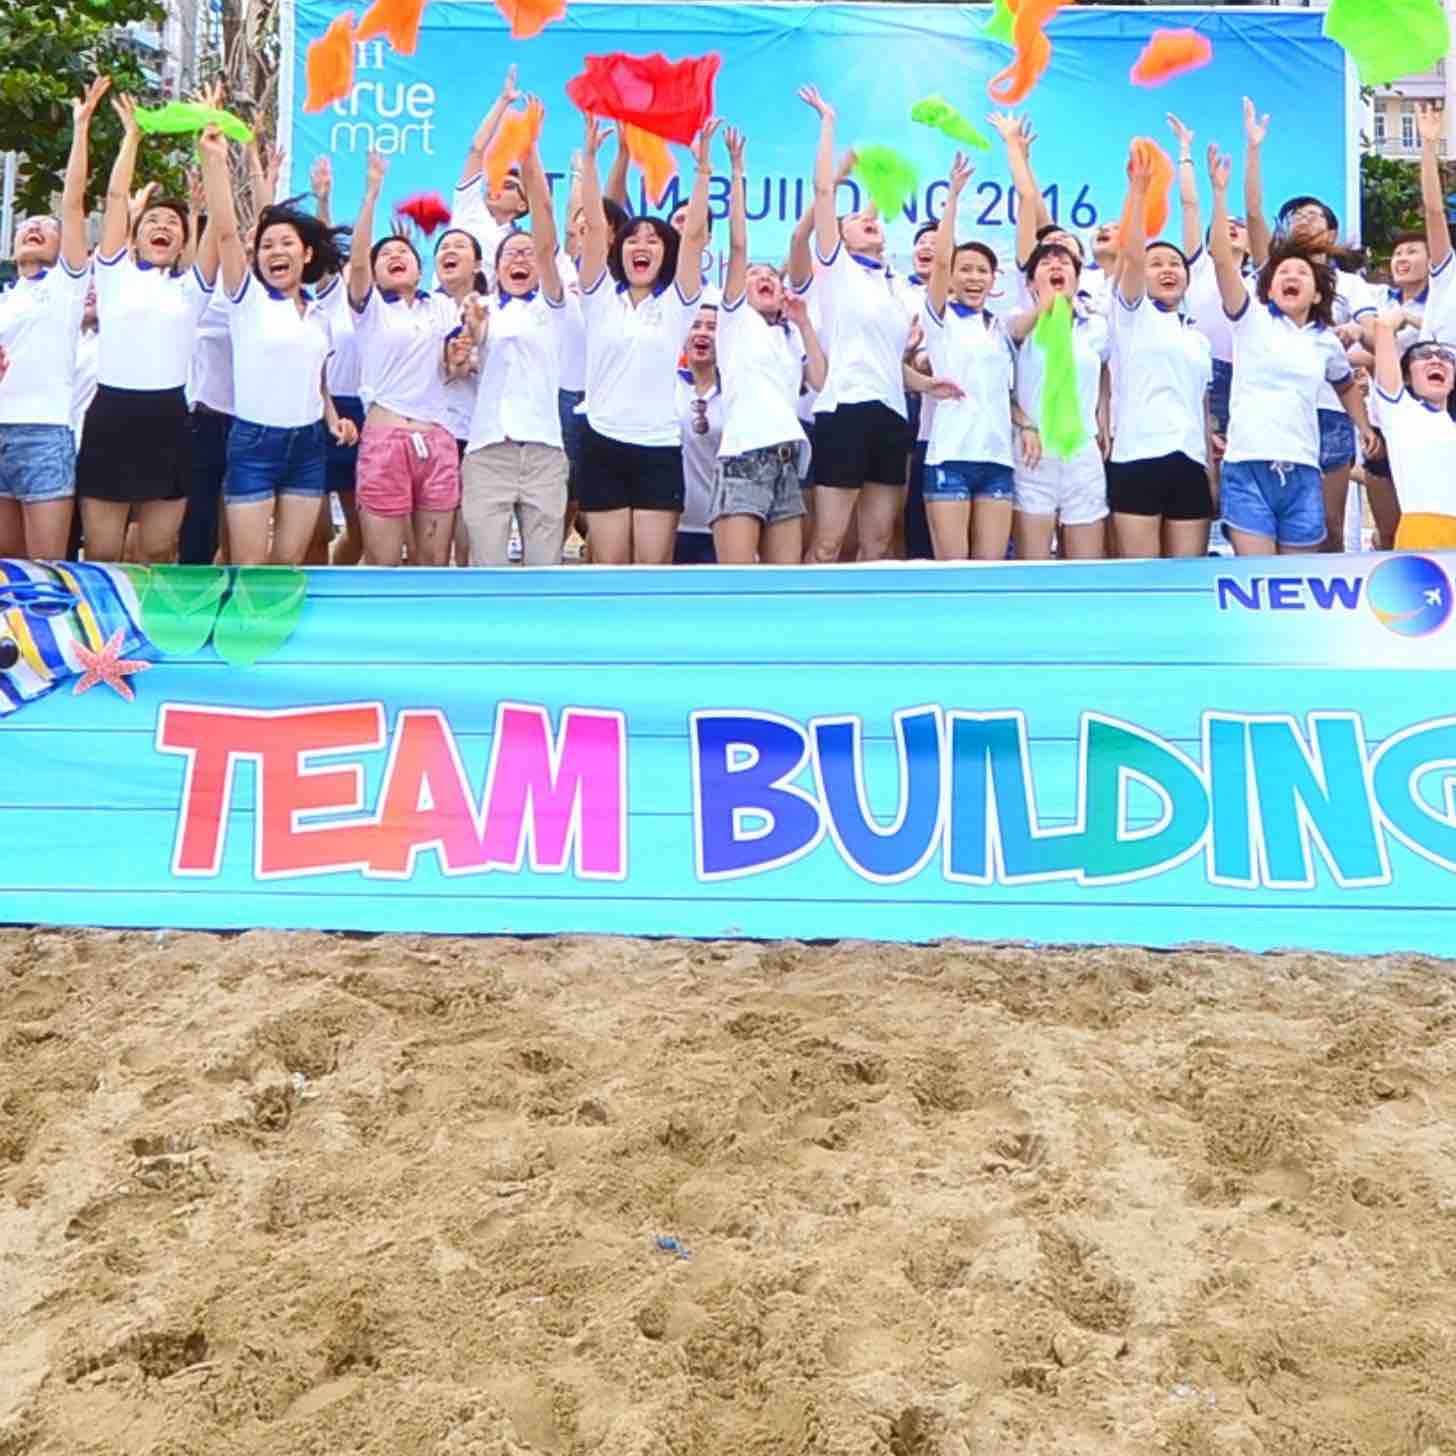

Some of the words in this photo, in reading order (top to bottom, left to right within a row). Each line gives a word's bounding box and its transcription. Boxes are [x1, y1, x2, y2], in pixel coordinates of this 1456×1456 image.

[330, 119, 437, 157] mart
[976, 180, 1098, 229] 2016
[154, 701, 628, 881] TEAM
